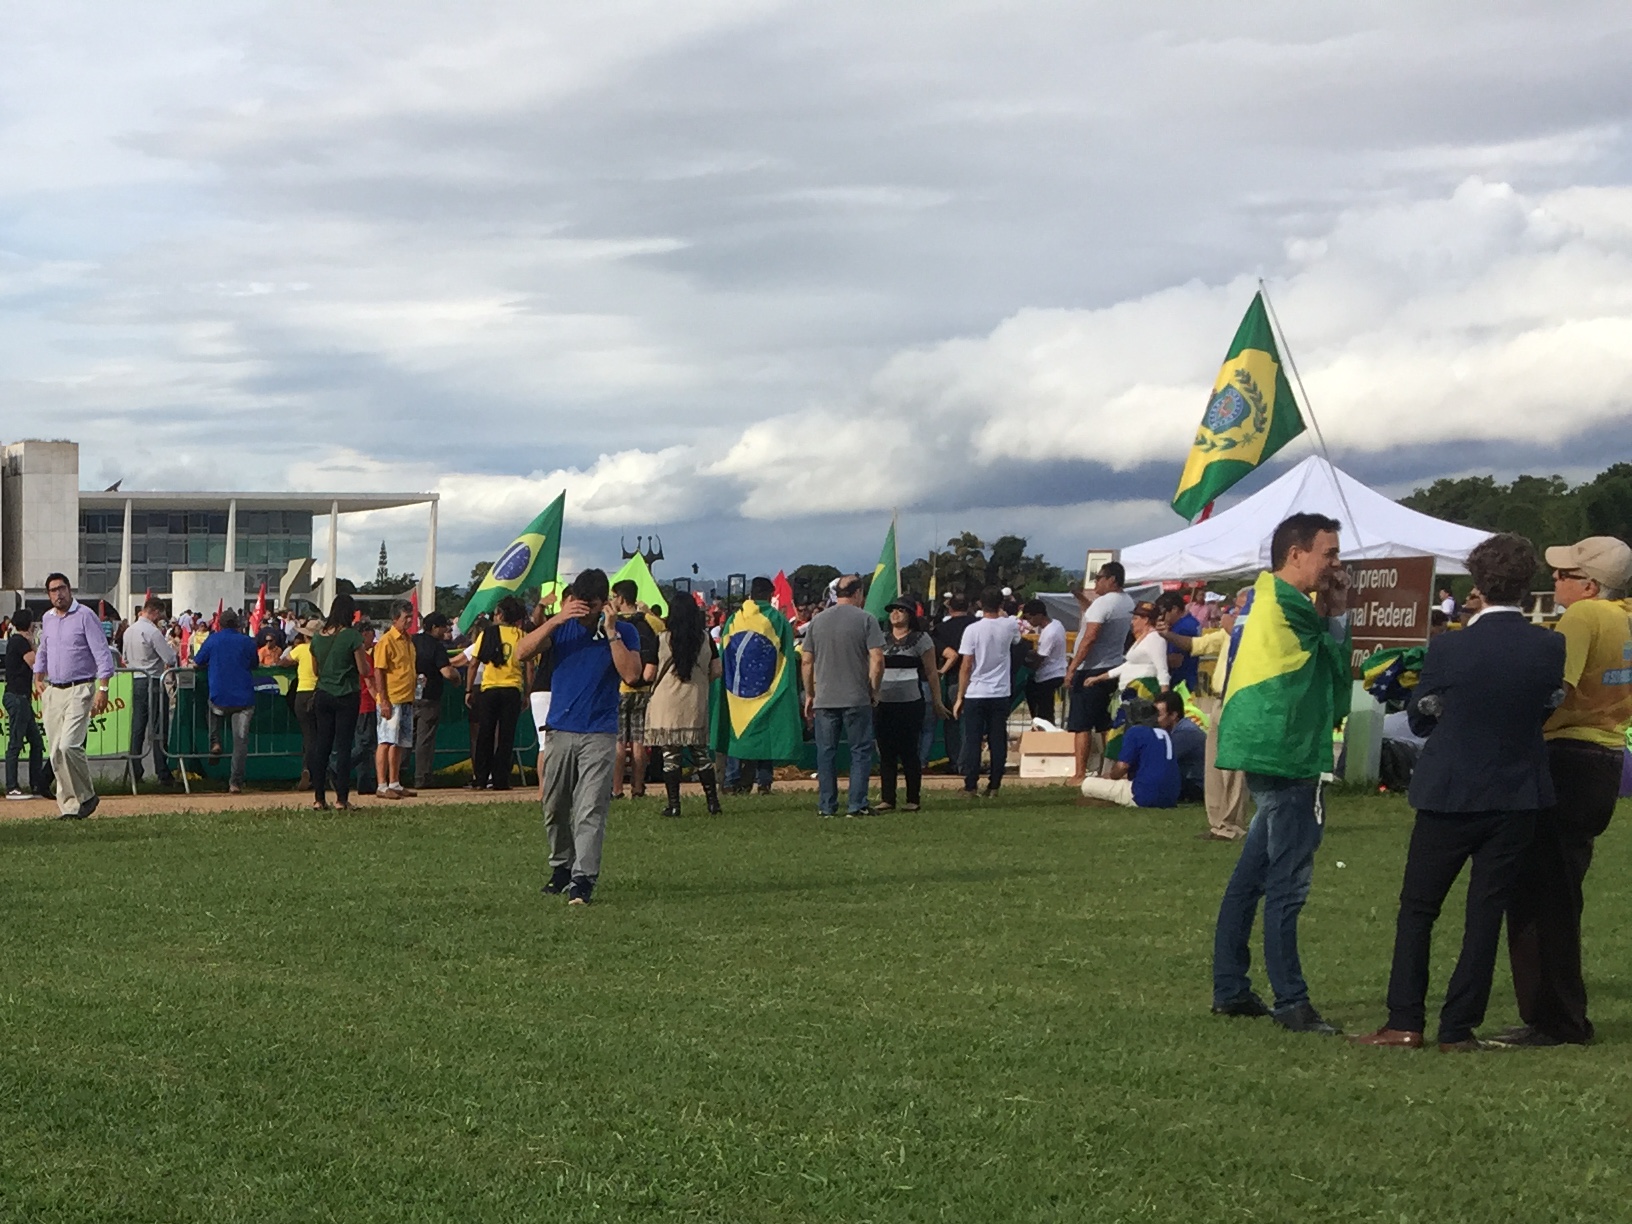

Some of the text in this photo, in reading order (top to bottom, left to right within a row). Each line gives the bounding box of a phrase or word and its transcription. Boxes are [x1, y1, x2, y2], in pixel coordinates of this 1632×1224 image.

[1345, 564, 1398, 595] Supremo
[1349, 601, 1417, 628] nal Federal
